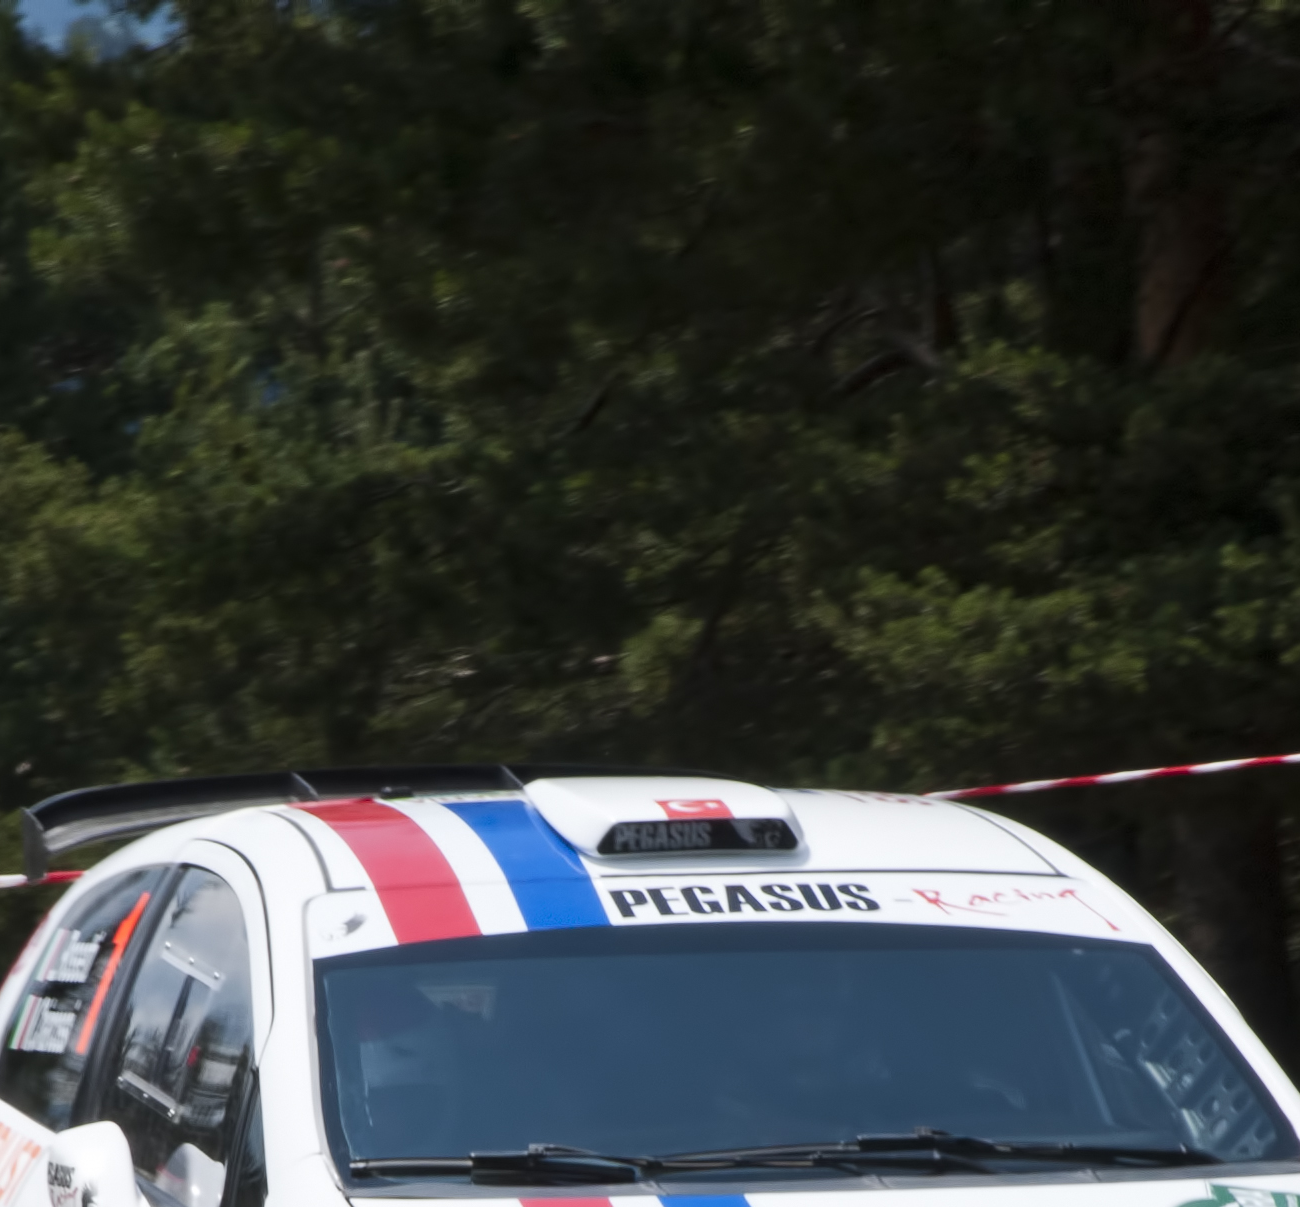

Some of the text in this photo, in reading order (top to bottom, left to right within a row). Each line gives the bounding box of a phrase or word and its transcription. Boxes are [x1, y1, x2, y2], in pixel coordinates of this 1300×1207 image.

[614, 823, 713, 850] PEGASUS
[609, 883, 1121, 931] PEGASUS Racing
